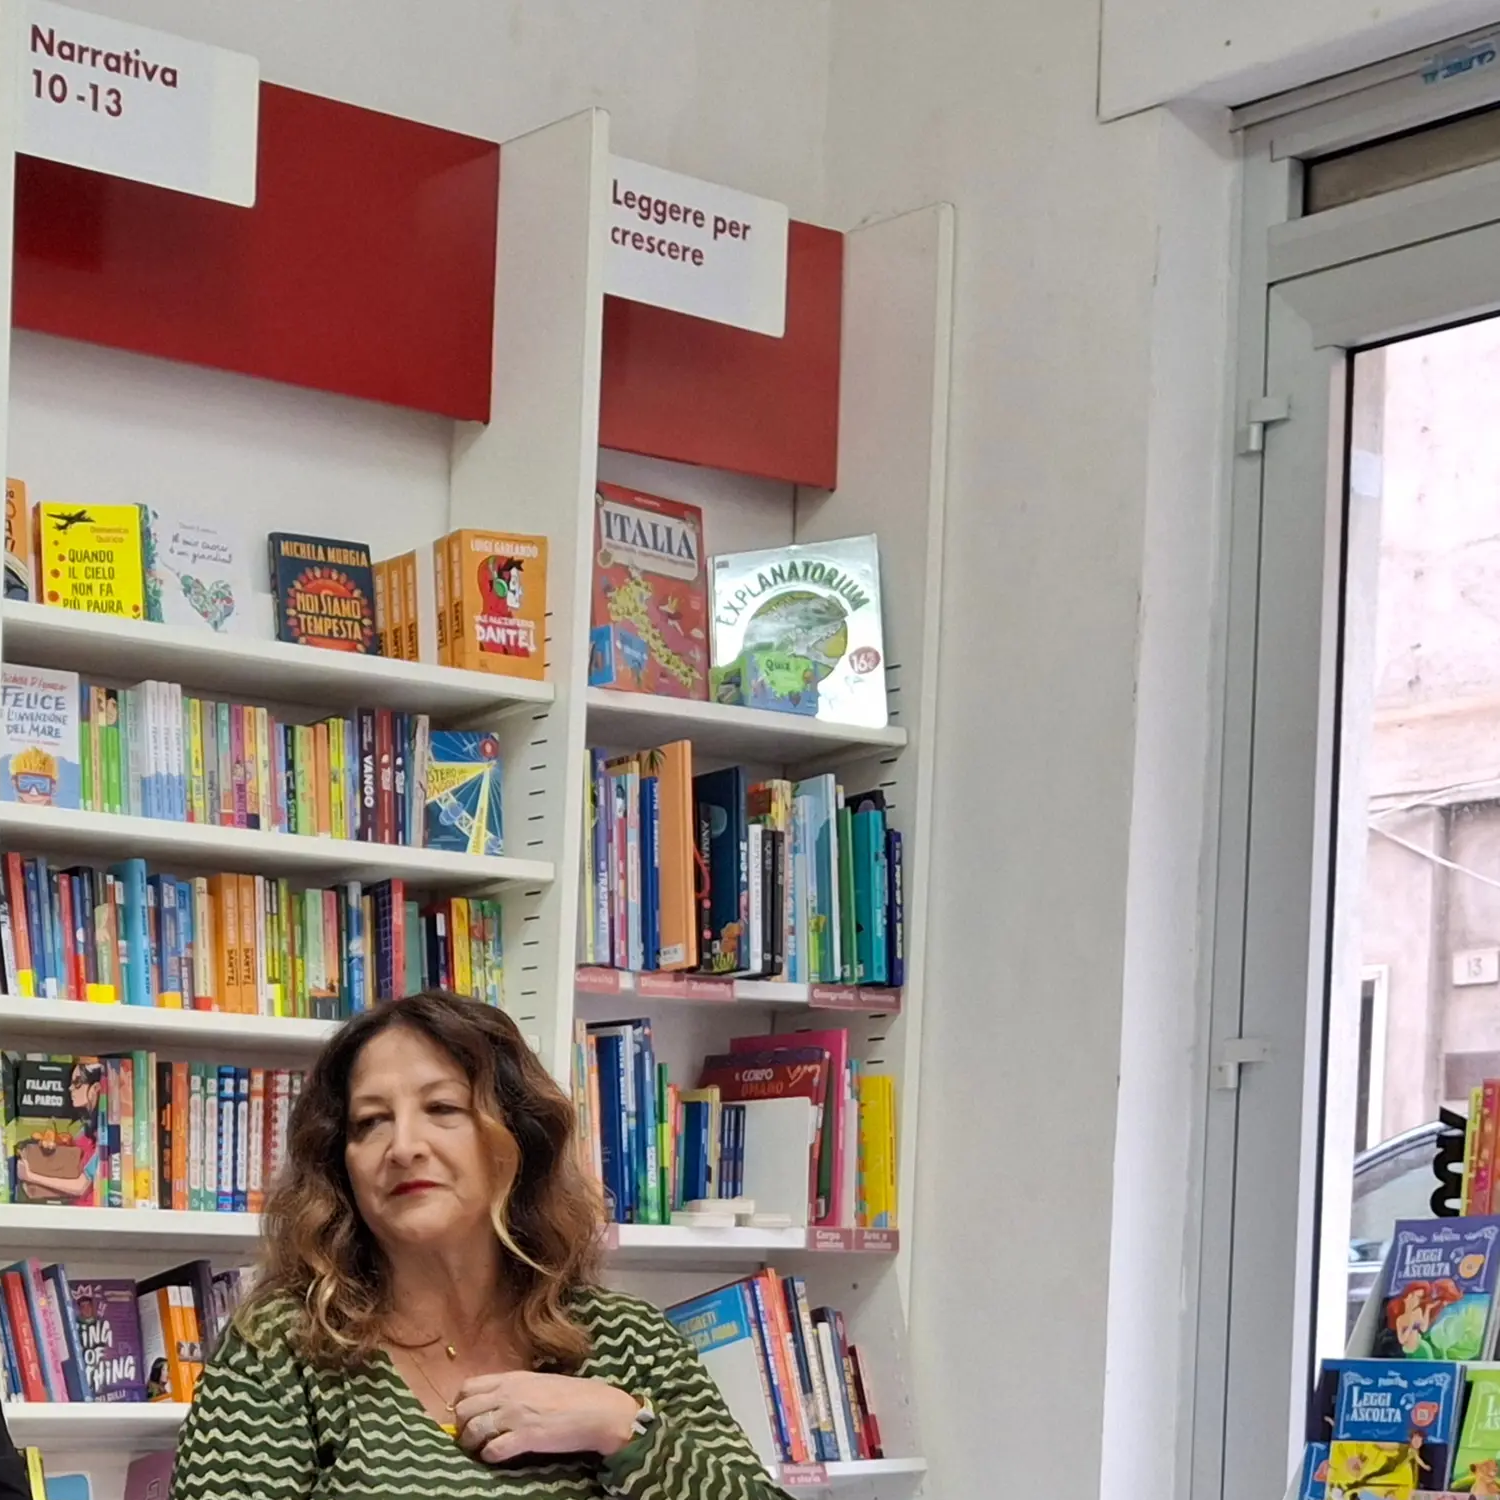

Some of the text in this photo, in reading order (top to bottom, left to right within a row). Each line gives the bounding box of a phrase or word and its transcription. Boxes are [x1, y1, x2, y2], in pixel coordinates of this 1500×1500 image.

[30, 23, 179, 89] Narrativa
[31, 68, 68, 104] 10
[611, 178, 752, 241] Leggere per
[610, 225, 705, 267] crescere
[603, 508, 696, 562] ITALIA
[67, 548, 114, 564] QUANDO
[279, 539, 369, 569] MICHELA MURGIA
[469, 538, 540, 559] LUIGI GARLANDO
[68, 566, 115, 580] IL CIELO
[71, 582, 114, 597] NON FA
[715, 559, 871, 628] EXPLANATORIUM
[86, 601, 124, 614] PAURA
[296, 591, 361, 619] NOI SIAMO
[298, 611, 362, 642] TEMPESTA
[0, 684, 67, 711] FELICE
[5, 722, 62, 740] DEL MARE
[362, 753, 376, 809] VANGO
[25, 1077, 65, 1093] FALAFEL
[21, 1094, 64, 1107] AL PARCO
[111, 1152, 121, 1181] META
[815, 1230, 841, 1241] Corpo
[1404, 1243, 1443, 1266] LEGGI
[1402, 1262, 1452, 1279] ASCOLTA
[80, 1320, 113, 1350] ING
[83, 1346, 107, 1366] OF
[1351, 1385, 1393, 1408] LEGGI
[1350, 1407, 1403, 1423] ASCOLTA
